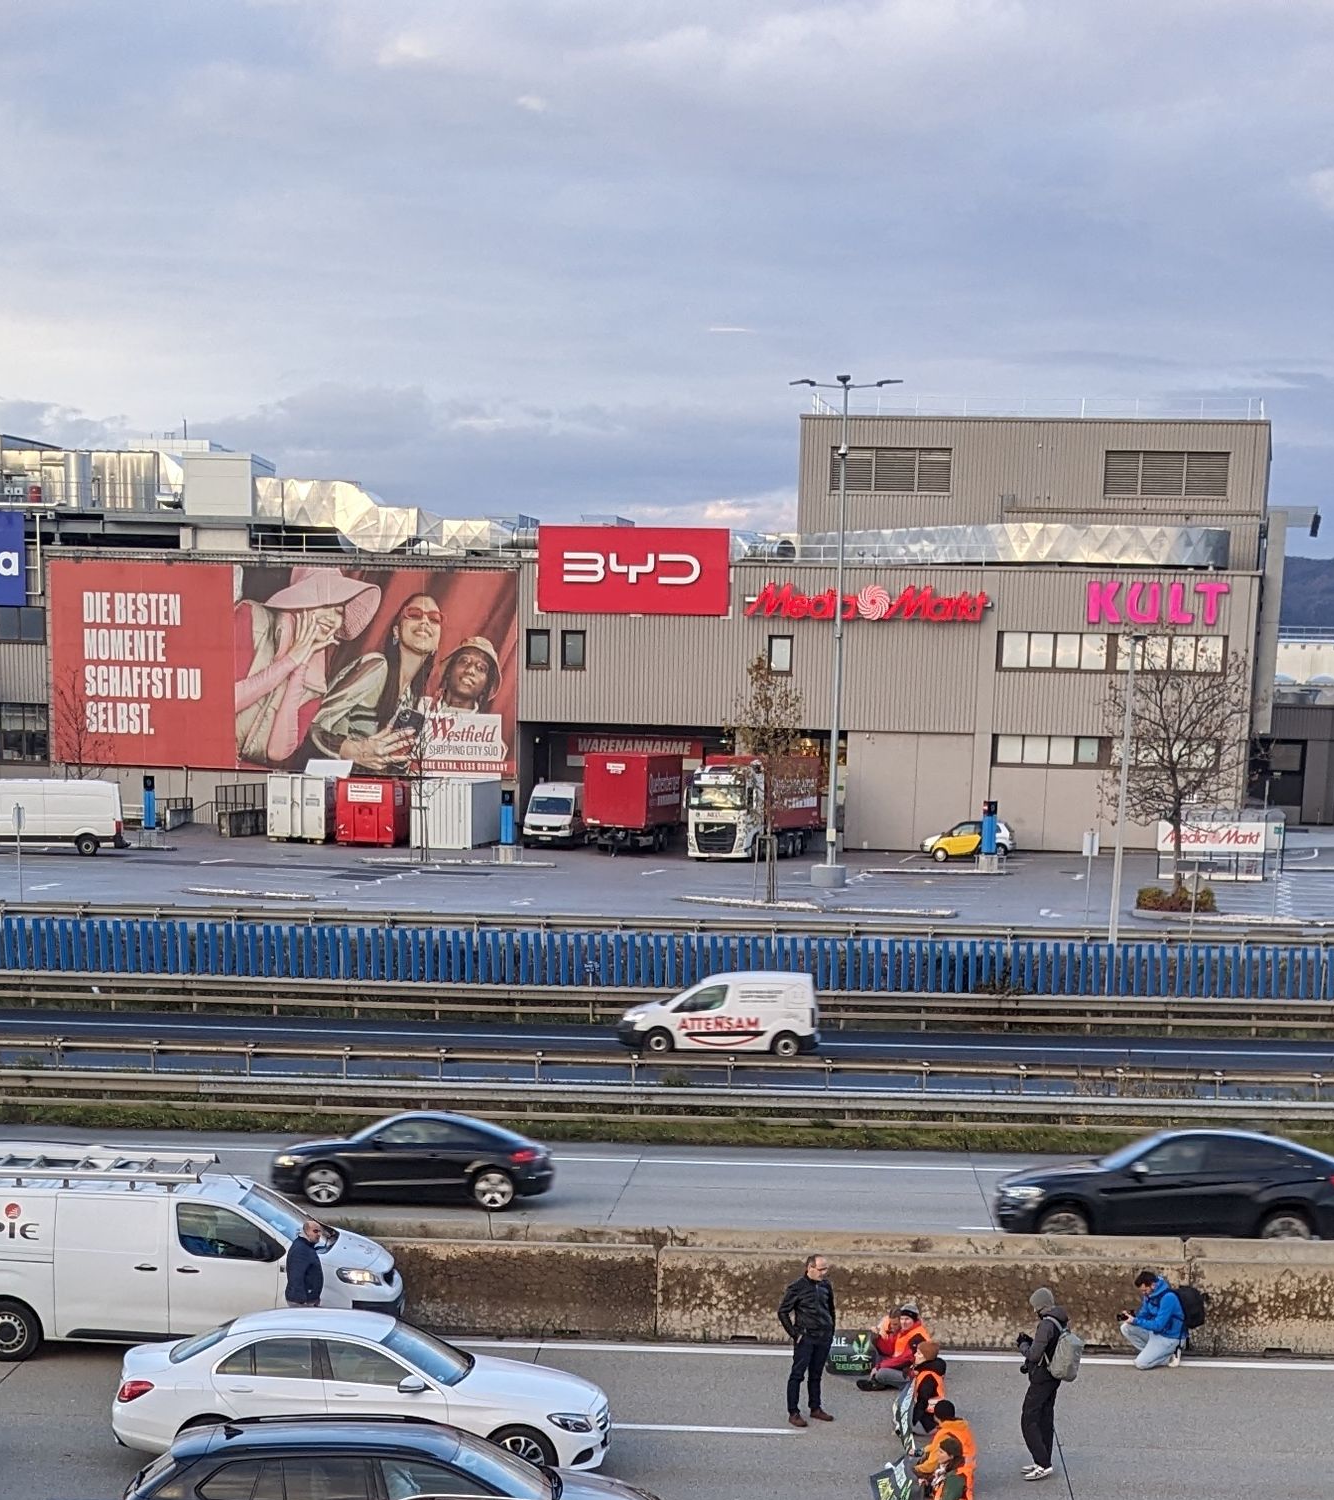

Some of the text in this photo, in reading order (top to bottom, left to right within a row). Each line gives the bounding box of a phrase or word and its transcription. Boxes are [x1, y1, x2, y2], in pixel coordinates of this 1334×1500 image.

[563, 551, 701, 585] BYD
[83, 591, 181, 626] DIE BESTEN
[744, 582, 988, 622] Media Markt
[1087, 580, 1230, 625] KULT
[83, 628, 166, 662] MOMENTE
[84, 664, 202, 700] SCHAFFST DU
[86, 701, 155, 735] SELBST.
[429, 716, 499, 744] Westfield
[428, 743, 499, 757] SHOPPING CITY SÜD
[577, 738, 692, 755] WARENANNAHME
[460, 762, 476, 771] LESS
[476, 762, 508, 772] ORDINARY
[1218, 829, 1261, 845] Markt
